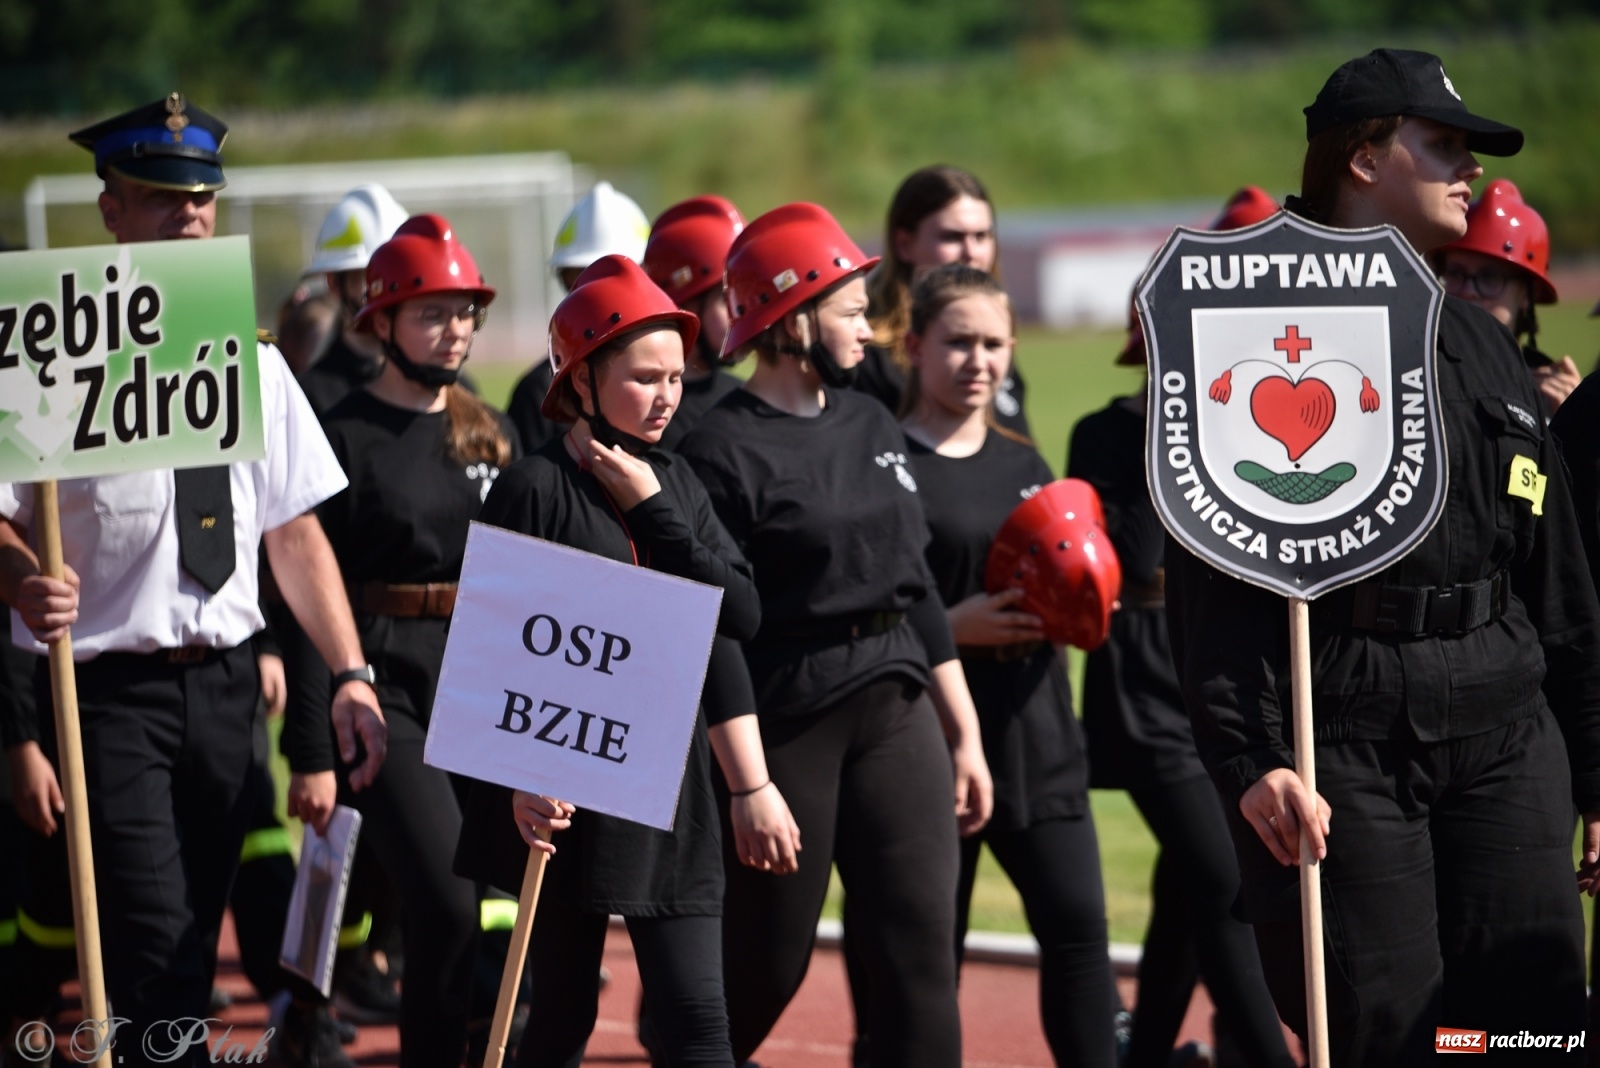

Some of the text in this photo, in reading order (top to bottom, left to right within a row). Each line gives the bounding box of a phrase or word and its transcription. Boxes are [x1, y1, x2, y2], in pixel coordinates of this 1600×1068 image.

[1181, 253, 1396, 290] RUPTAWA
[73, 339, 240, 451] Zdrój
[1162, 366, 1426, 564] OCHOTNICZA STRAŻ POŻARNA
[521, 613, 632, 676] OSP
[495, 689, 631, 764] BZIE
